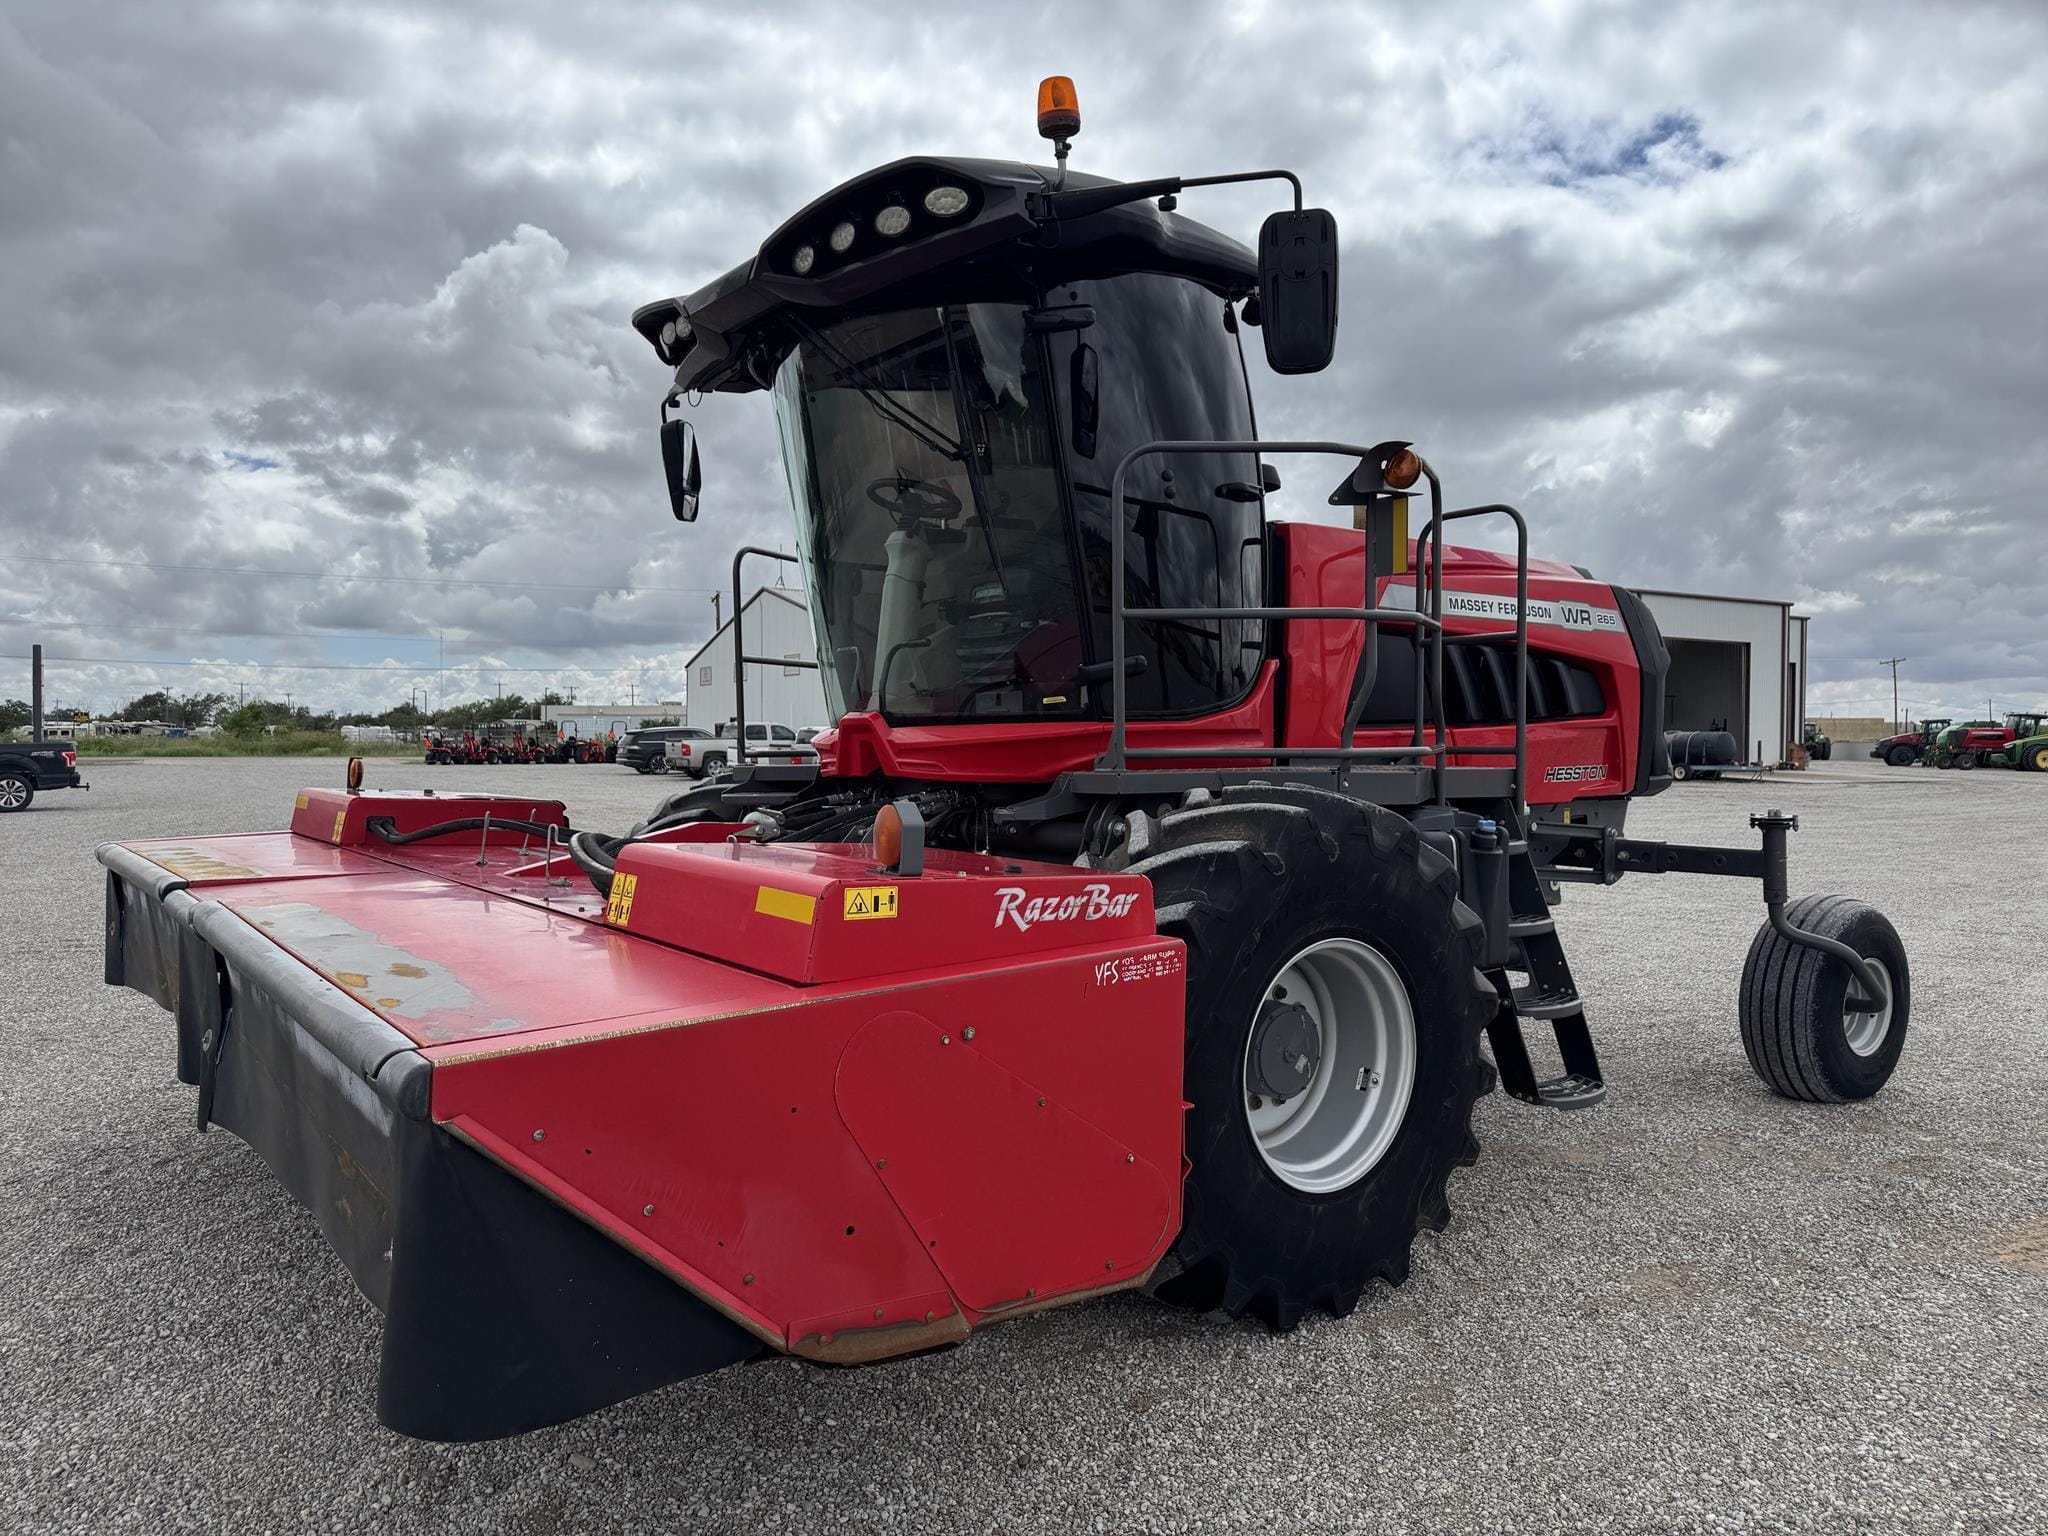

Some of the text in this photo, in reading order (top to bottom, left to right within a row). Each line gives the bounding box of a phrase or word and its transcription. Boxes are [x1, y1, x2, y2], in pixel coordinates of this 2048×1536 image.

[1448, 597, 1552, 619] MASSEY FERUSON
[1560, 605, 1616, 626] WR 265
[1543, 764, 1609, 783] HESSTON
[1095, 959, 1120, 987] YFS
